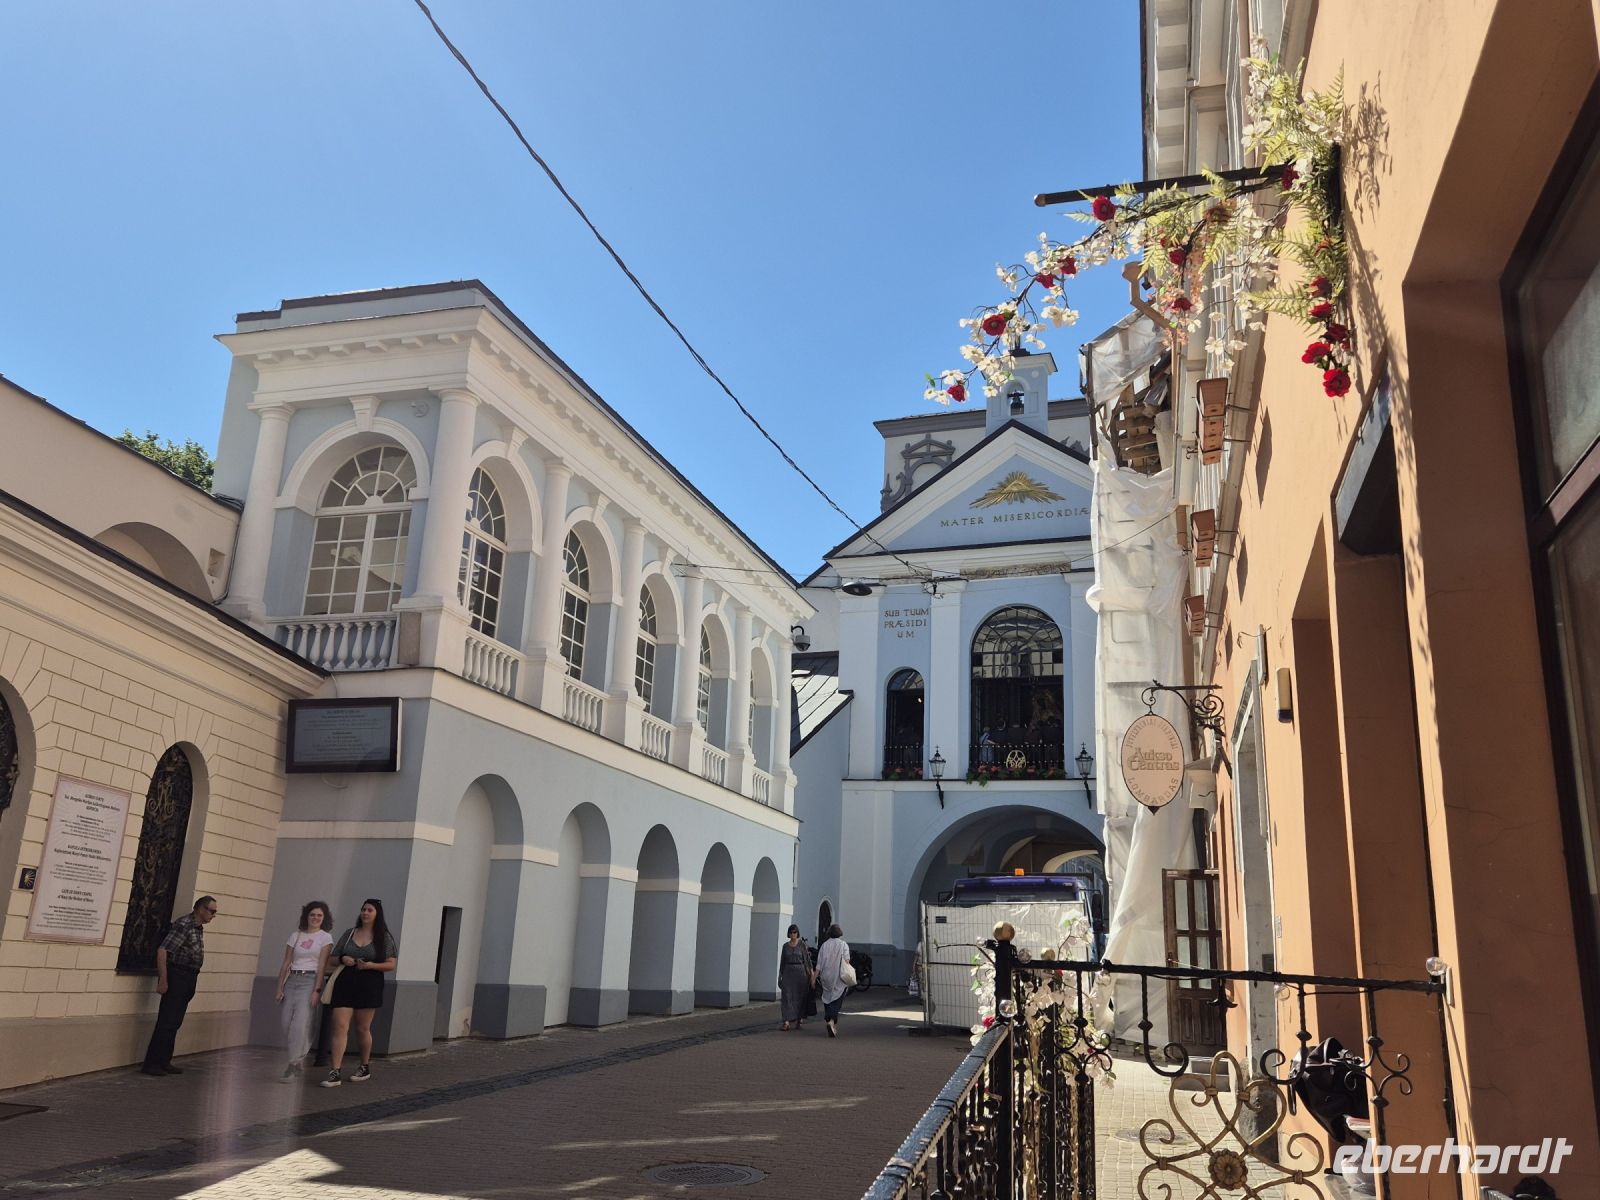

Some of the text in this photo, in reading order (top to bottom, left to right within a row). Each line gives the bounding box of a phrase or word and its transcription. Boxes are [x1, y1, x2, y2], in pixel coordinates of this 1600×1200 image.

[940, 517, 984, 528] MATER
[884, 608, 929, 617] SUB TUUM
[1127, 777, 1179, 805] LOMBARDAS
